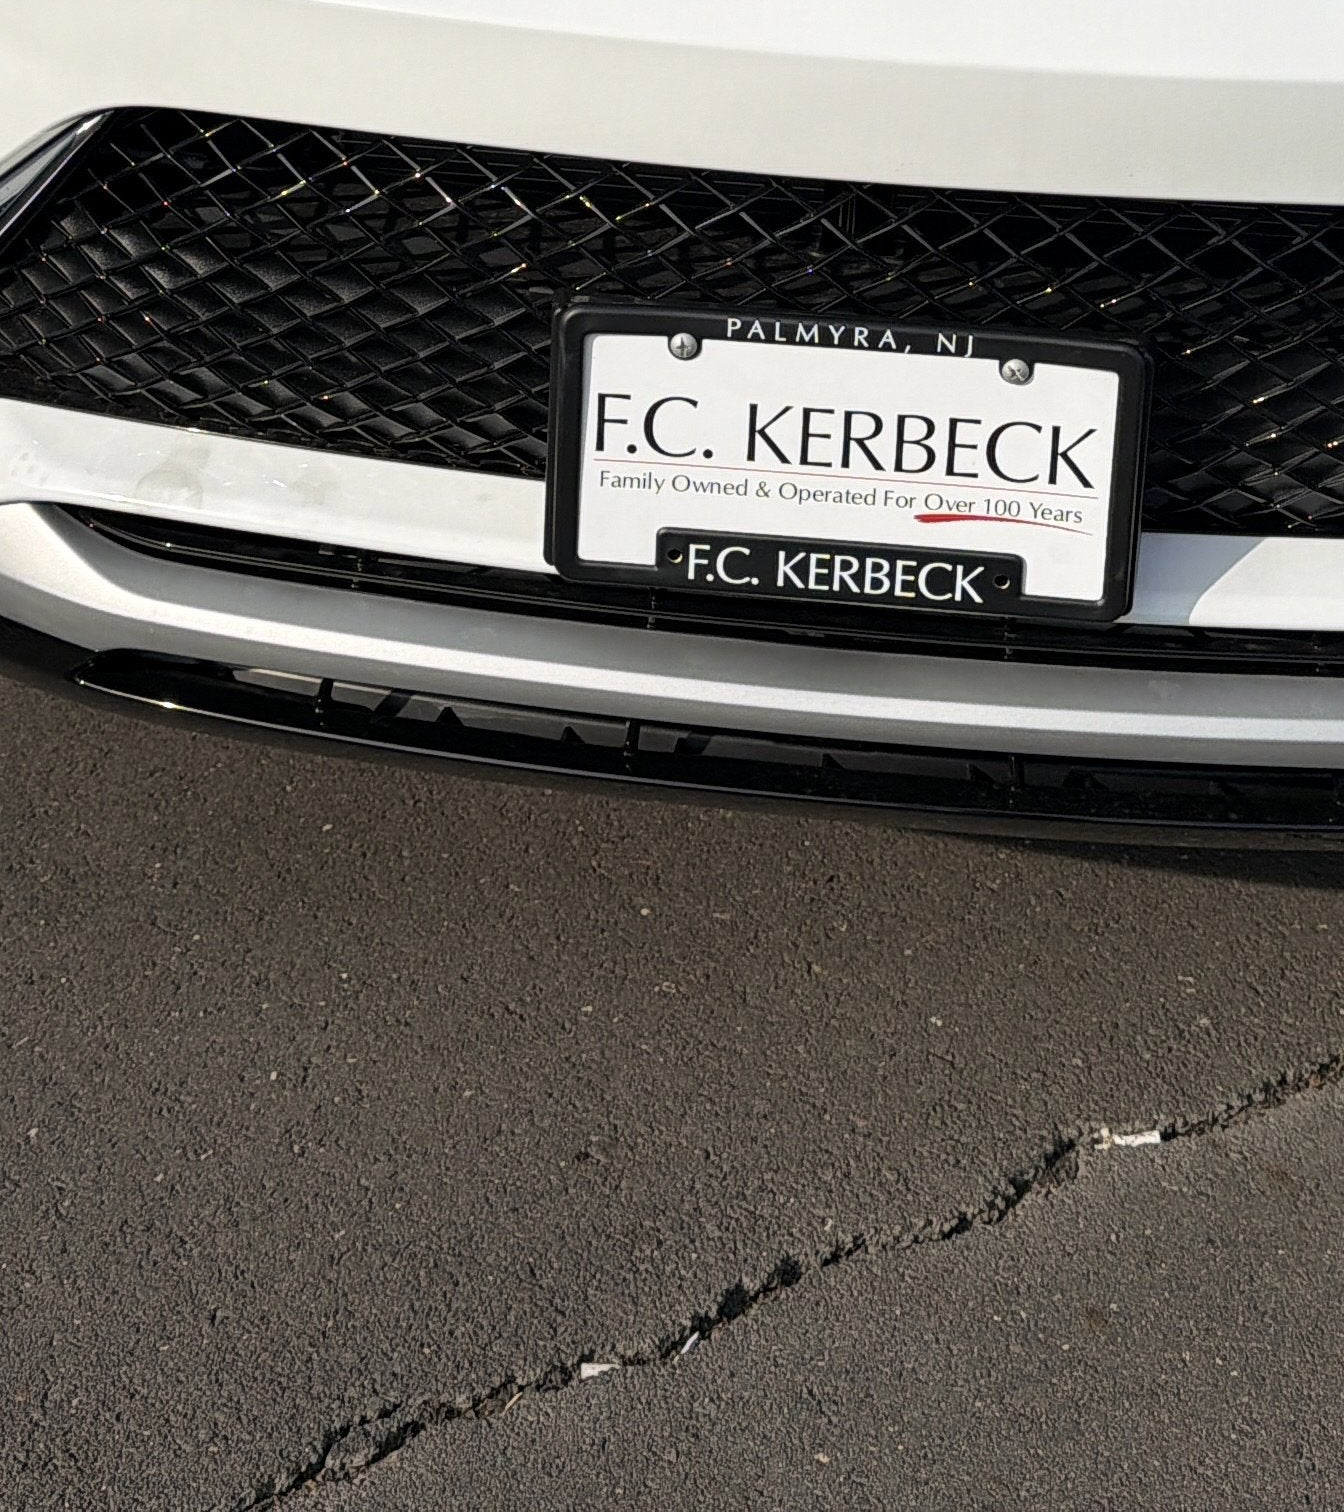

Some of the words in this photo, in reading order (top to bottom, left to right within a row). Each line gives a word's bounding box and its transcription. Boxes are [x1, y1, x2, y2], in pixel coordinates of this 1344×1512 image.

[726, 318, 912, 355] PALMYRA,
[936, 333, 974, 358] NJ
[595, 392, 714, 459] F.C.
[746, 402, 1098, 490] KERBECK
[600, 470, 666, 495] Family
[671, 474, 749, 497] Owned
[755, 481, 771, 498] &
[778, 482, 877, 506] Operated
[883, 490, 917, 509] For
[924, 493, 977, 514] Over
[984, 498, 1022, 517] 100
[1029, 501, 1084, 524] Years
[687, 543, 760, 586] F.C.
[776, 550, 986, 605] KERBECK
